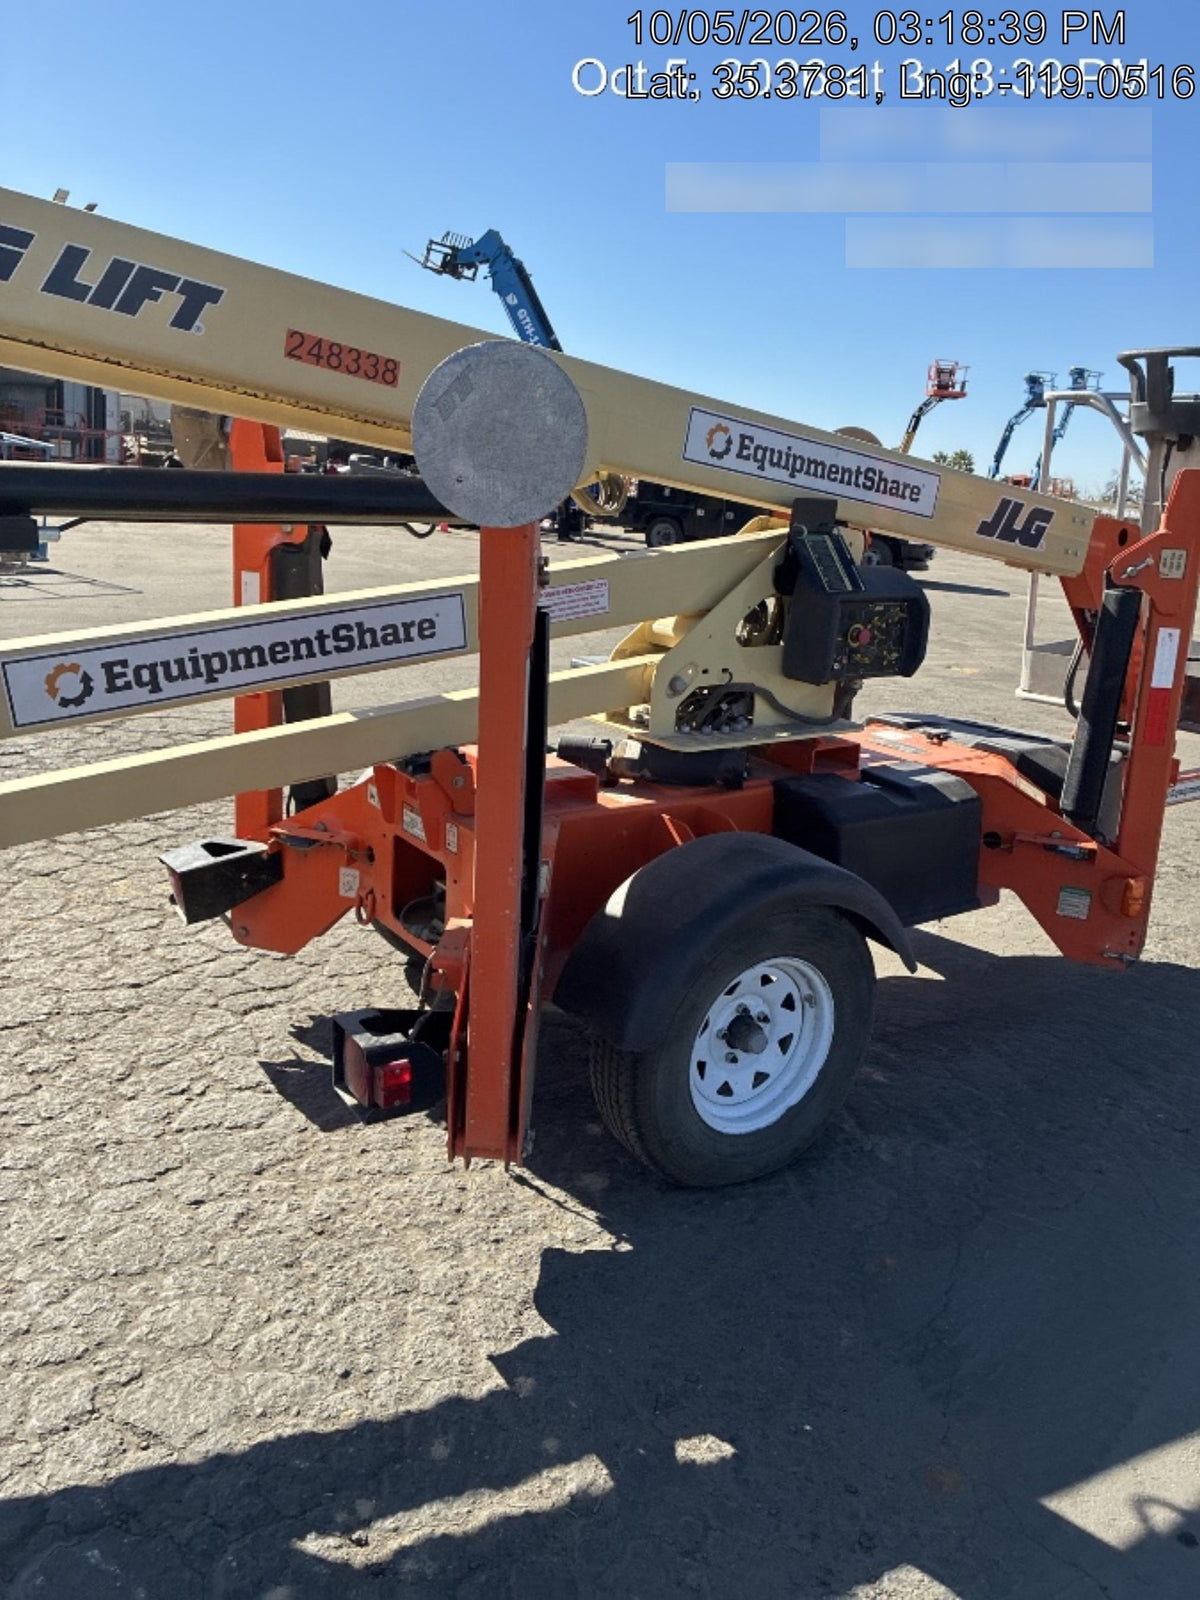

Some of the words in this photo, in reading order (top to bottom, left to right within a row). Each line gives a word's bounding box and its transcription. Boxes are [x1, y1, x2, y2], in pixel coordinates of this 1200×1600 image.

[40, 242, 227, 333] LIFT
[286, 330, 398, 386] 248338
[735, 433, 922, 503] EquipmentShare
[975, 497, 1056, 549] JLG
[100, 616, 437, 694] EquipmentShare
